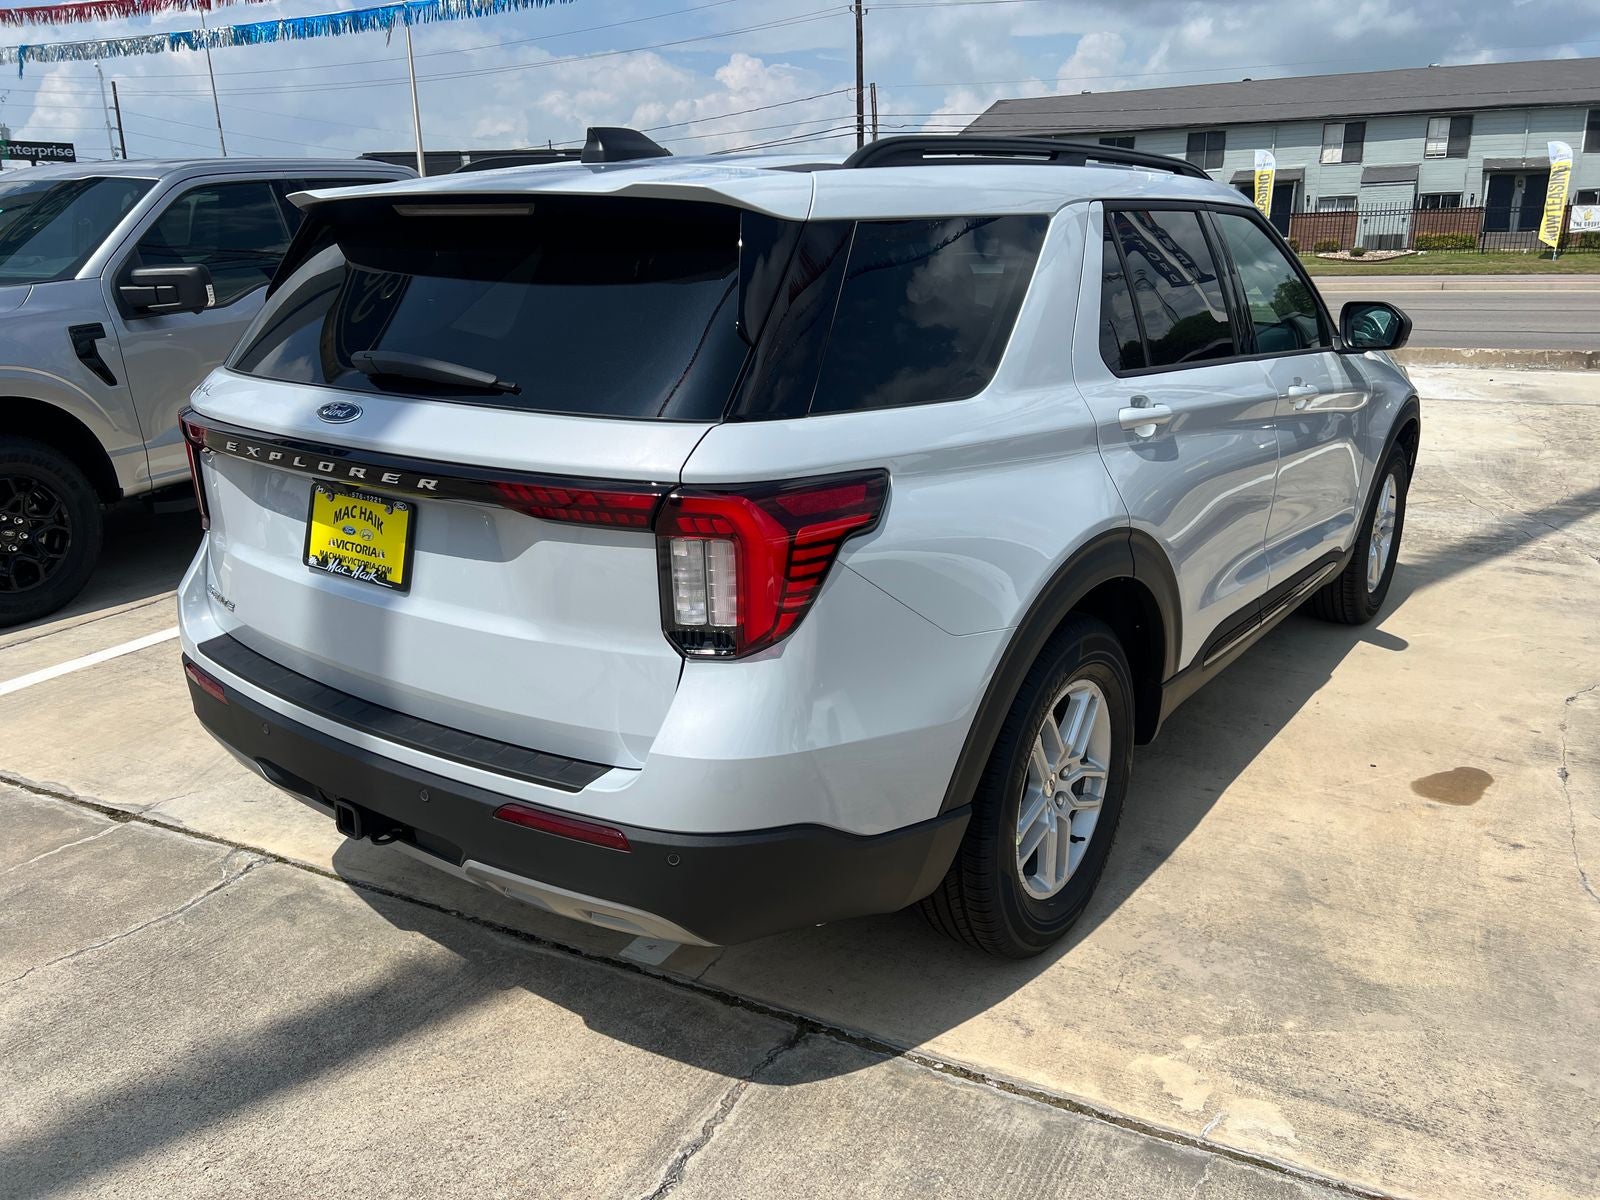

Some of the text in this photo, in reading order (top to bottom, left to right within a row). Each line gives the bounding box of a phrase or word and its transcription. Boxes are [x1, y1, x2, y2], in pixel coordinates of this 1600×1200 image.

[0, 144, 74, 159] enterprise
[1546, 164, 1570, 215] LEASING
[1543, 215, 1560, 242] NOW
[322, 402, 352, 418] Ford
[225, 440, 440, 491] EXPLORER
[333, 505, 384, 535] MAC HAIK
[335, 538, 378, 558] VICTORIA
[326, 558, 379, 582] Mac Haik
